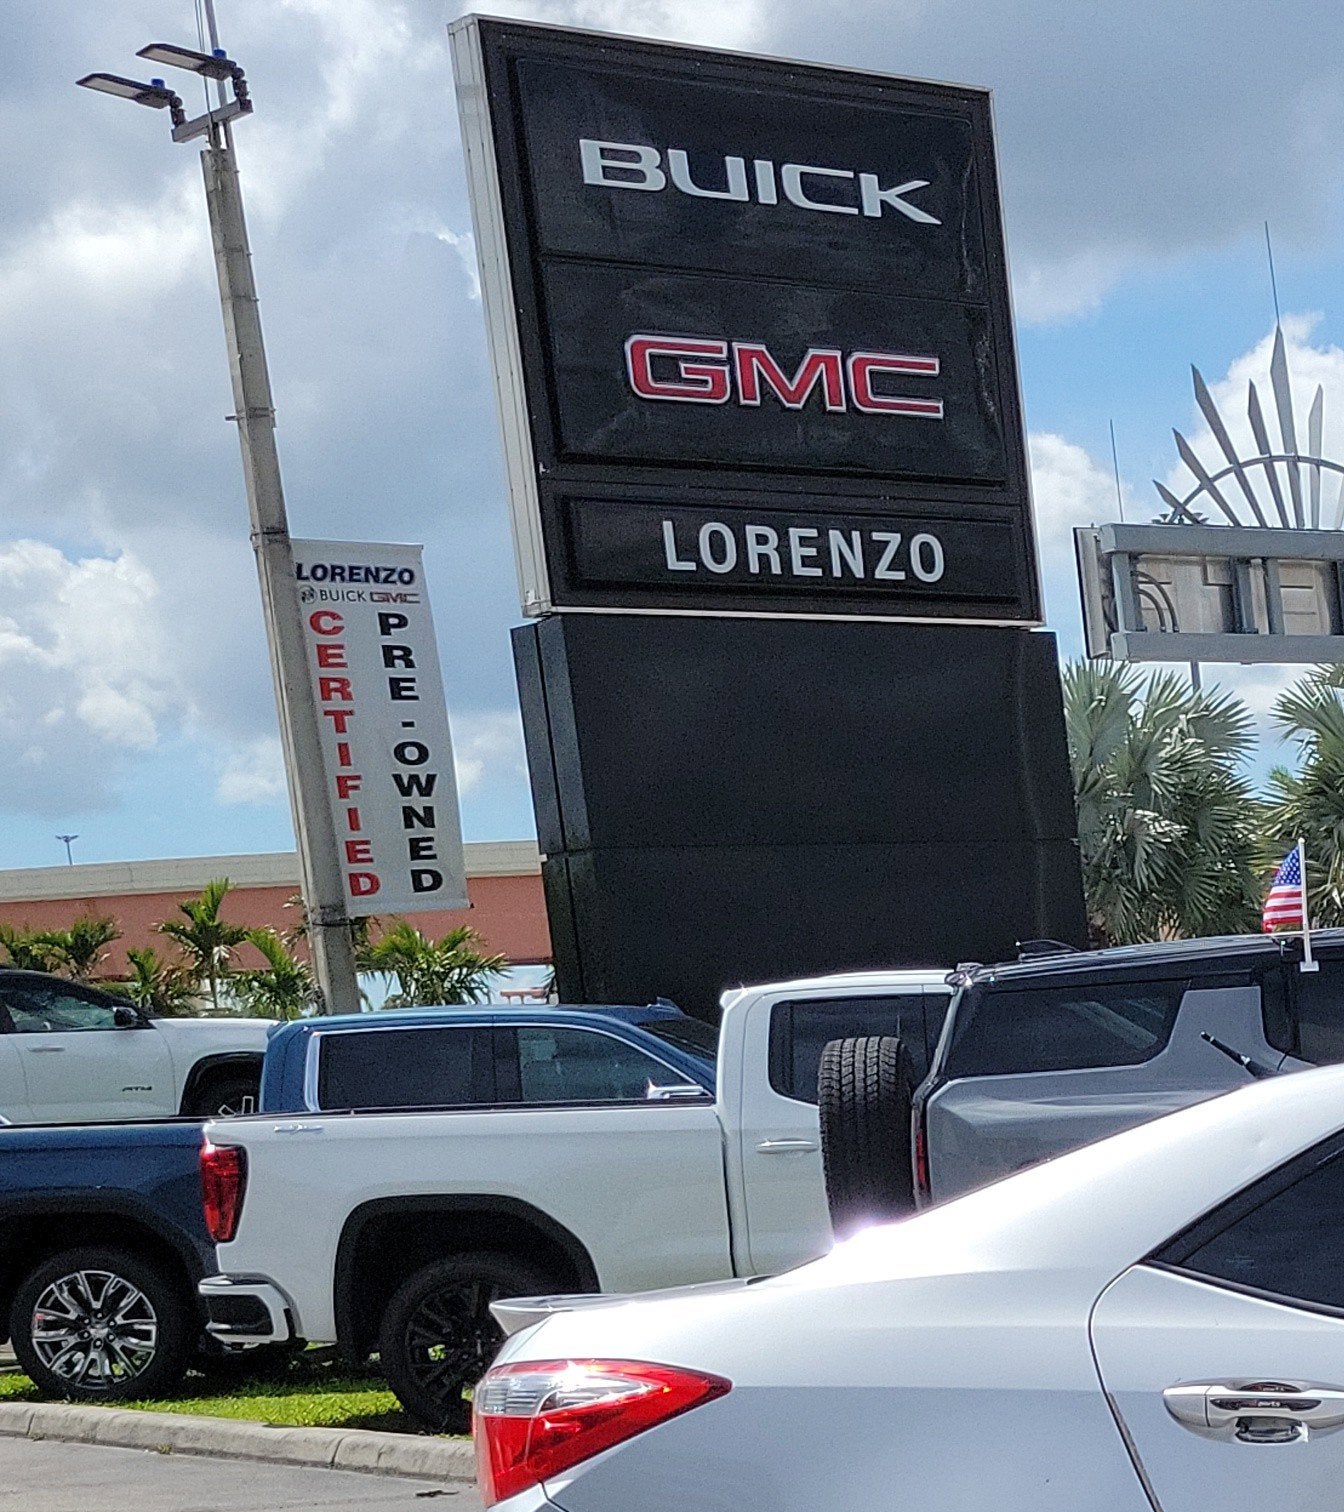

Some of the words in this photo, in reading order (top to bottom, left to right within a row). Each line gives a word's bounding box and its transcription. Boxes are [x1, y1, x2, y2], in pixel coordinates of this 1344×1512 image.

[578, 137, 943, 226] BUICK
[624, 332, 944, 420] GMC
[295, 561, 415, 586] LORENZO
[661, 519, 946, 584] LORENZO
[319, 588, 367, 603] BUICK
[369, 590, 421, 604] GMC
[308, 609, 382, 897] CERTIFIED
[376, 611, 444, 894] PRE-OWNED
